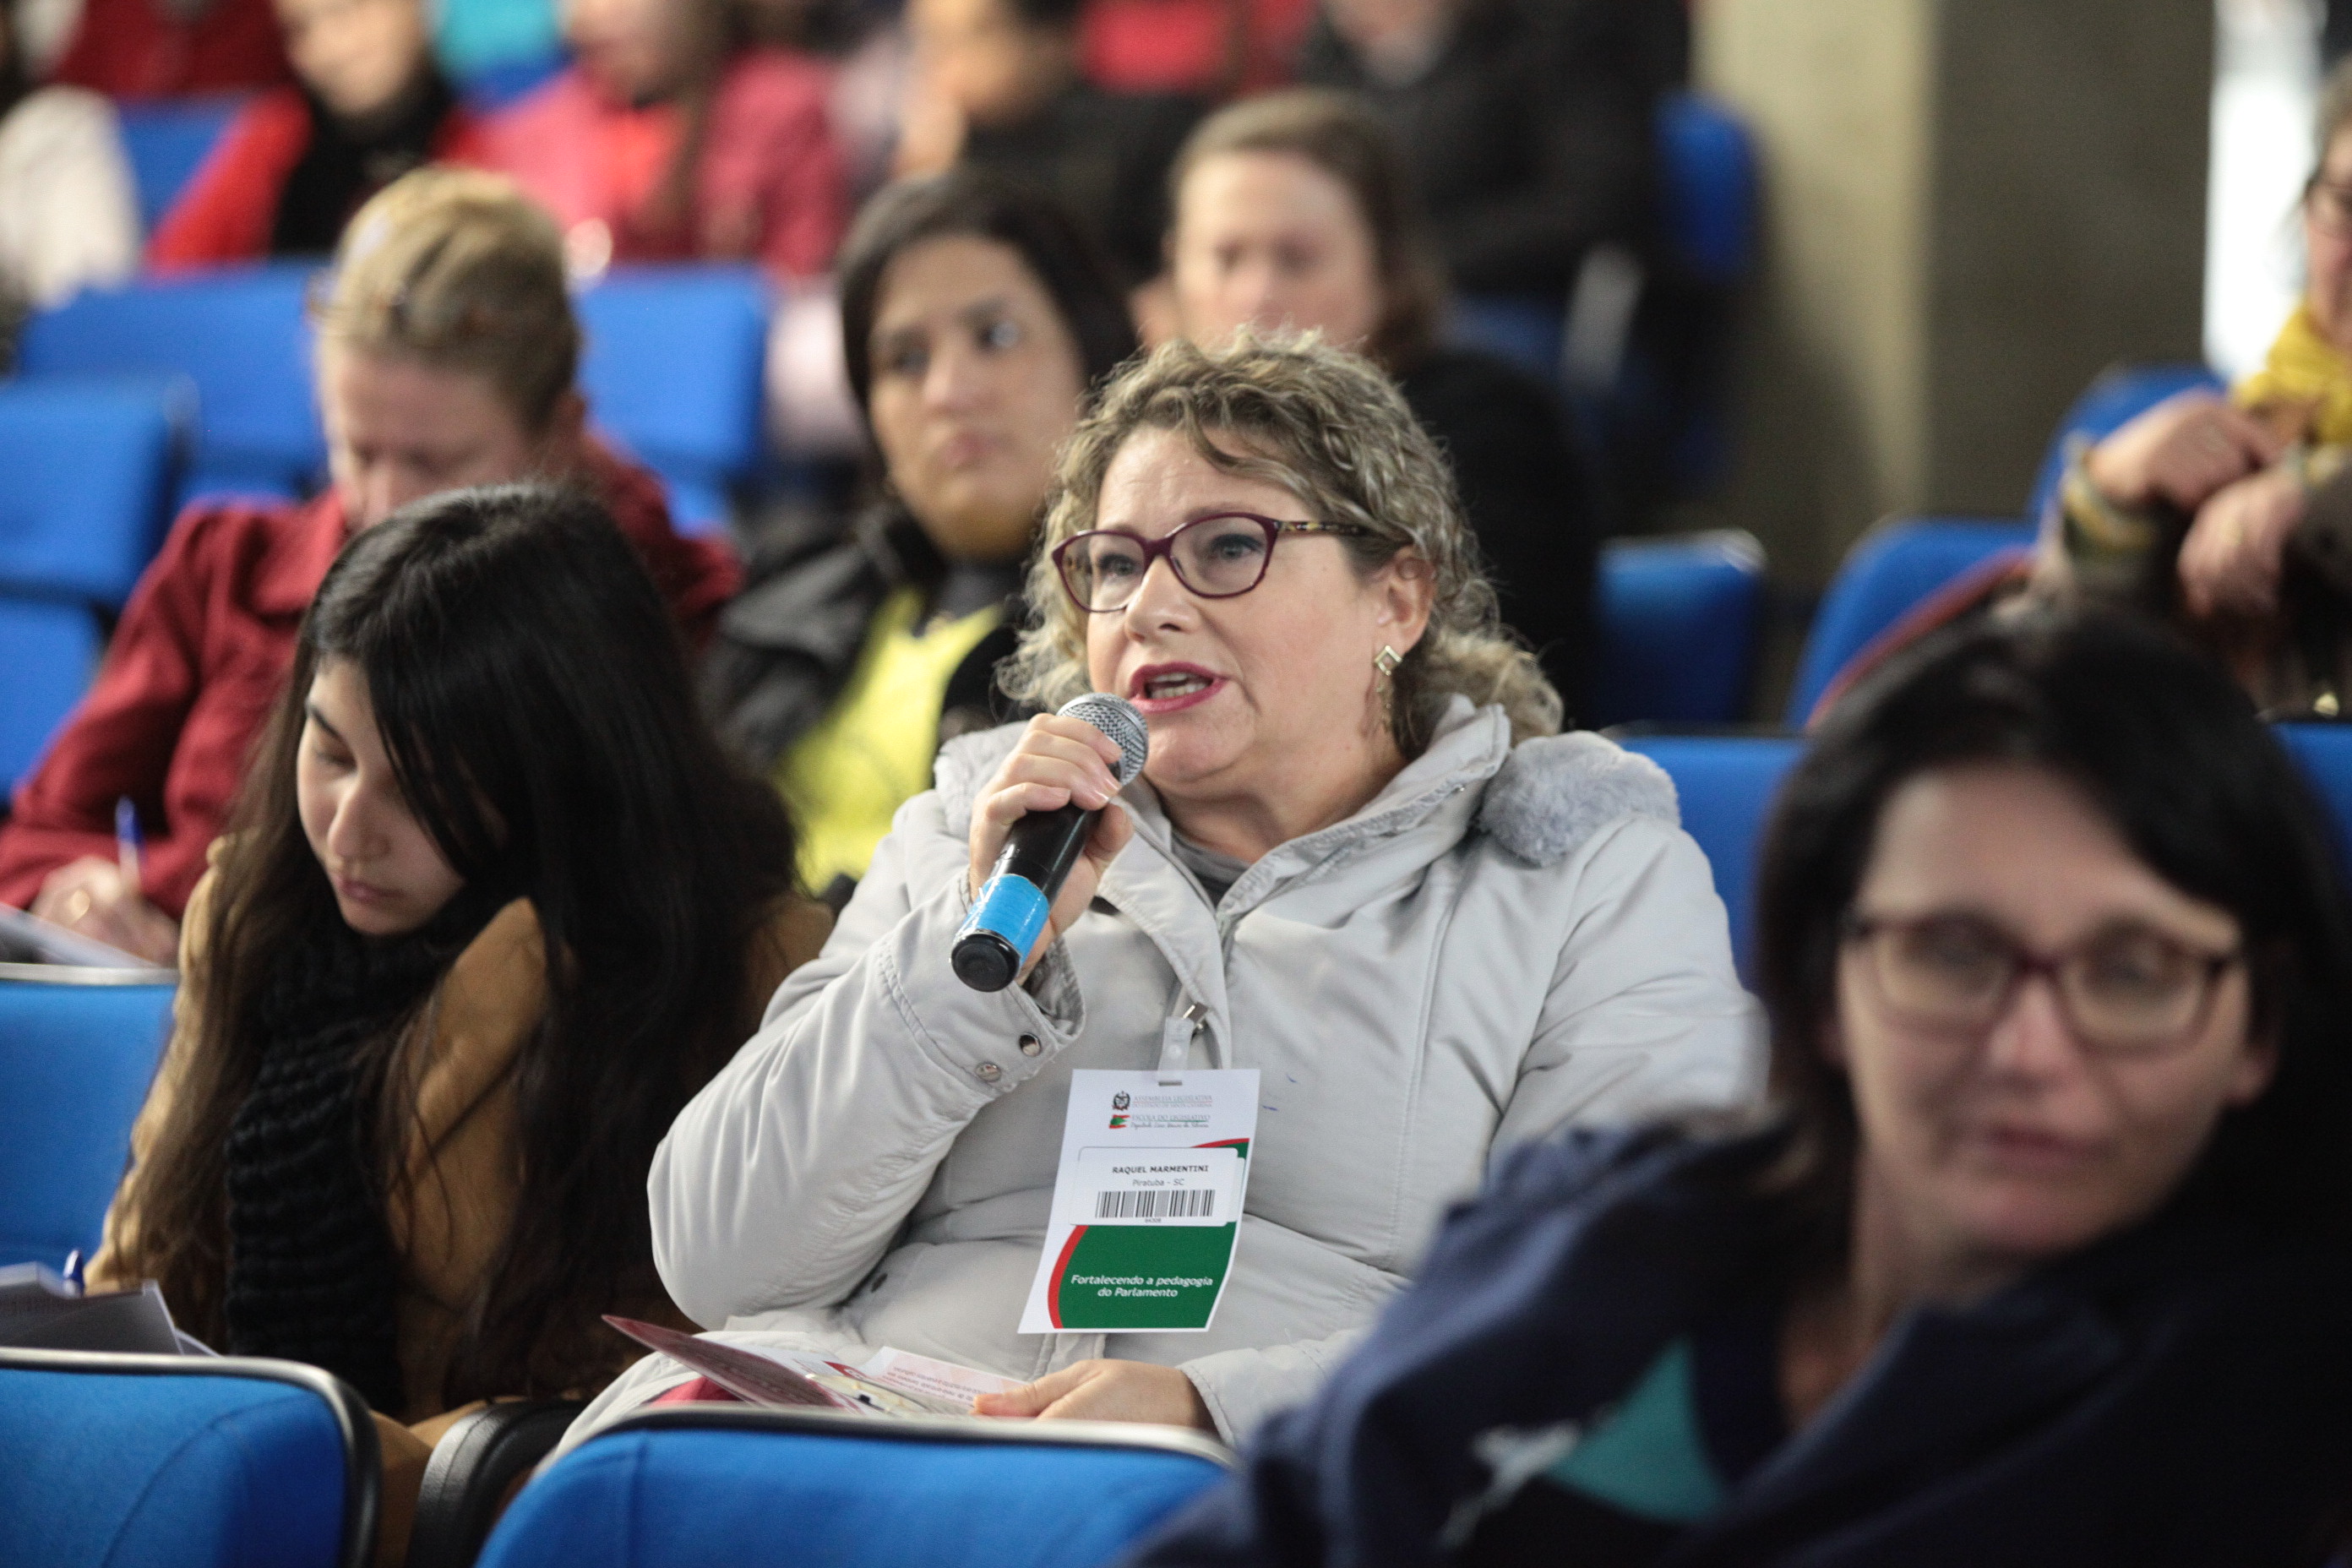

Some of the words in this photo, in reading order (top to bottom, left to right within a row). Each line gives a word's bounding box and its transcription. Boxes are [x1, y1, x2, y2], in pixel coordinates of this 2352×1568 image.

[1112, 1166, 1147, 1174] RAQUEL
[1150, 1165, 1209, 1173] MARMENTINI
[1173, 1178, 1184, 1186] SC
[1070, 1274, 1144, 1285] Fortalecendo
[1146, 1277, 1153, 1285] a
[1156, 1276, 1213, 1288] pedagogia
[1097, 1287, 1112, 1297] do
[1114, 1287, 1178, 1297] Parlamento
